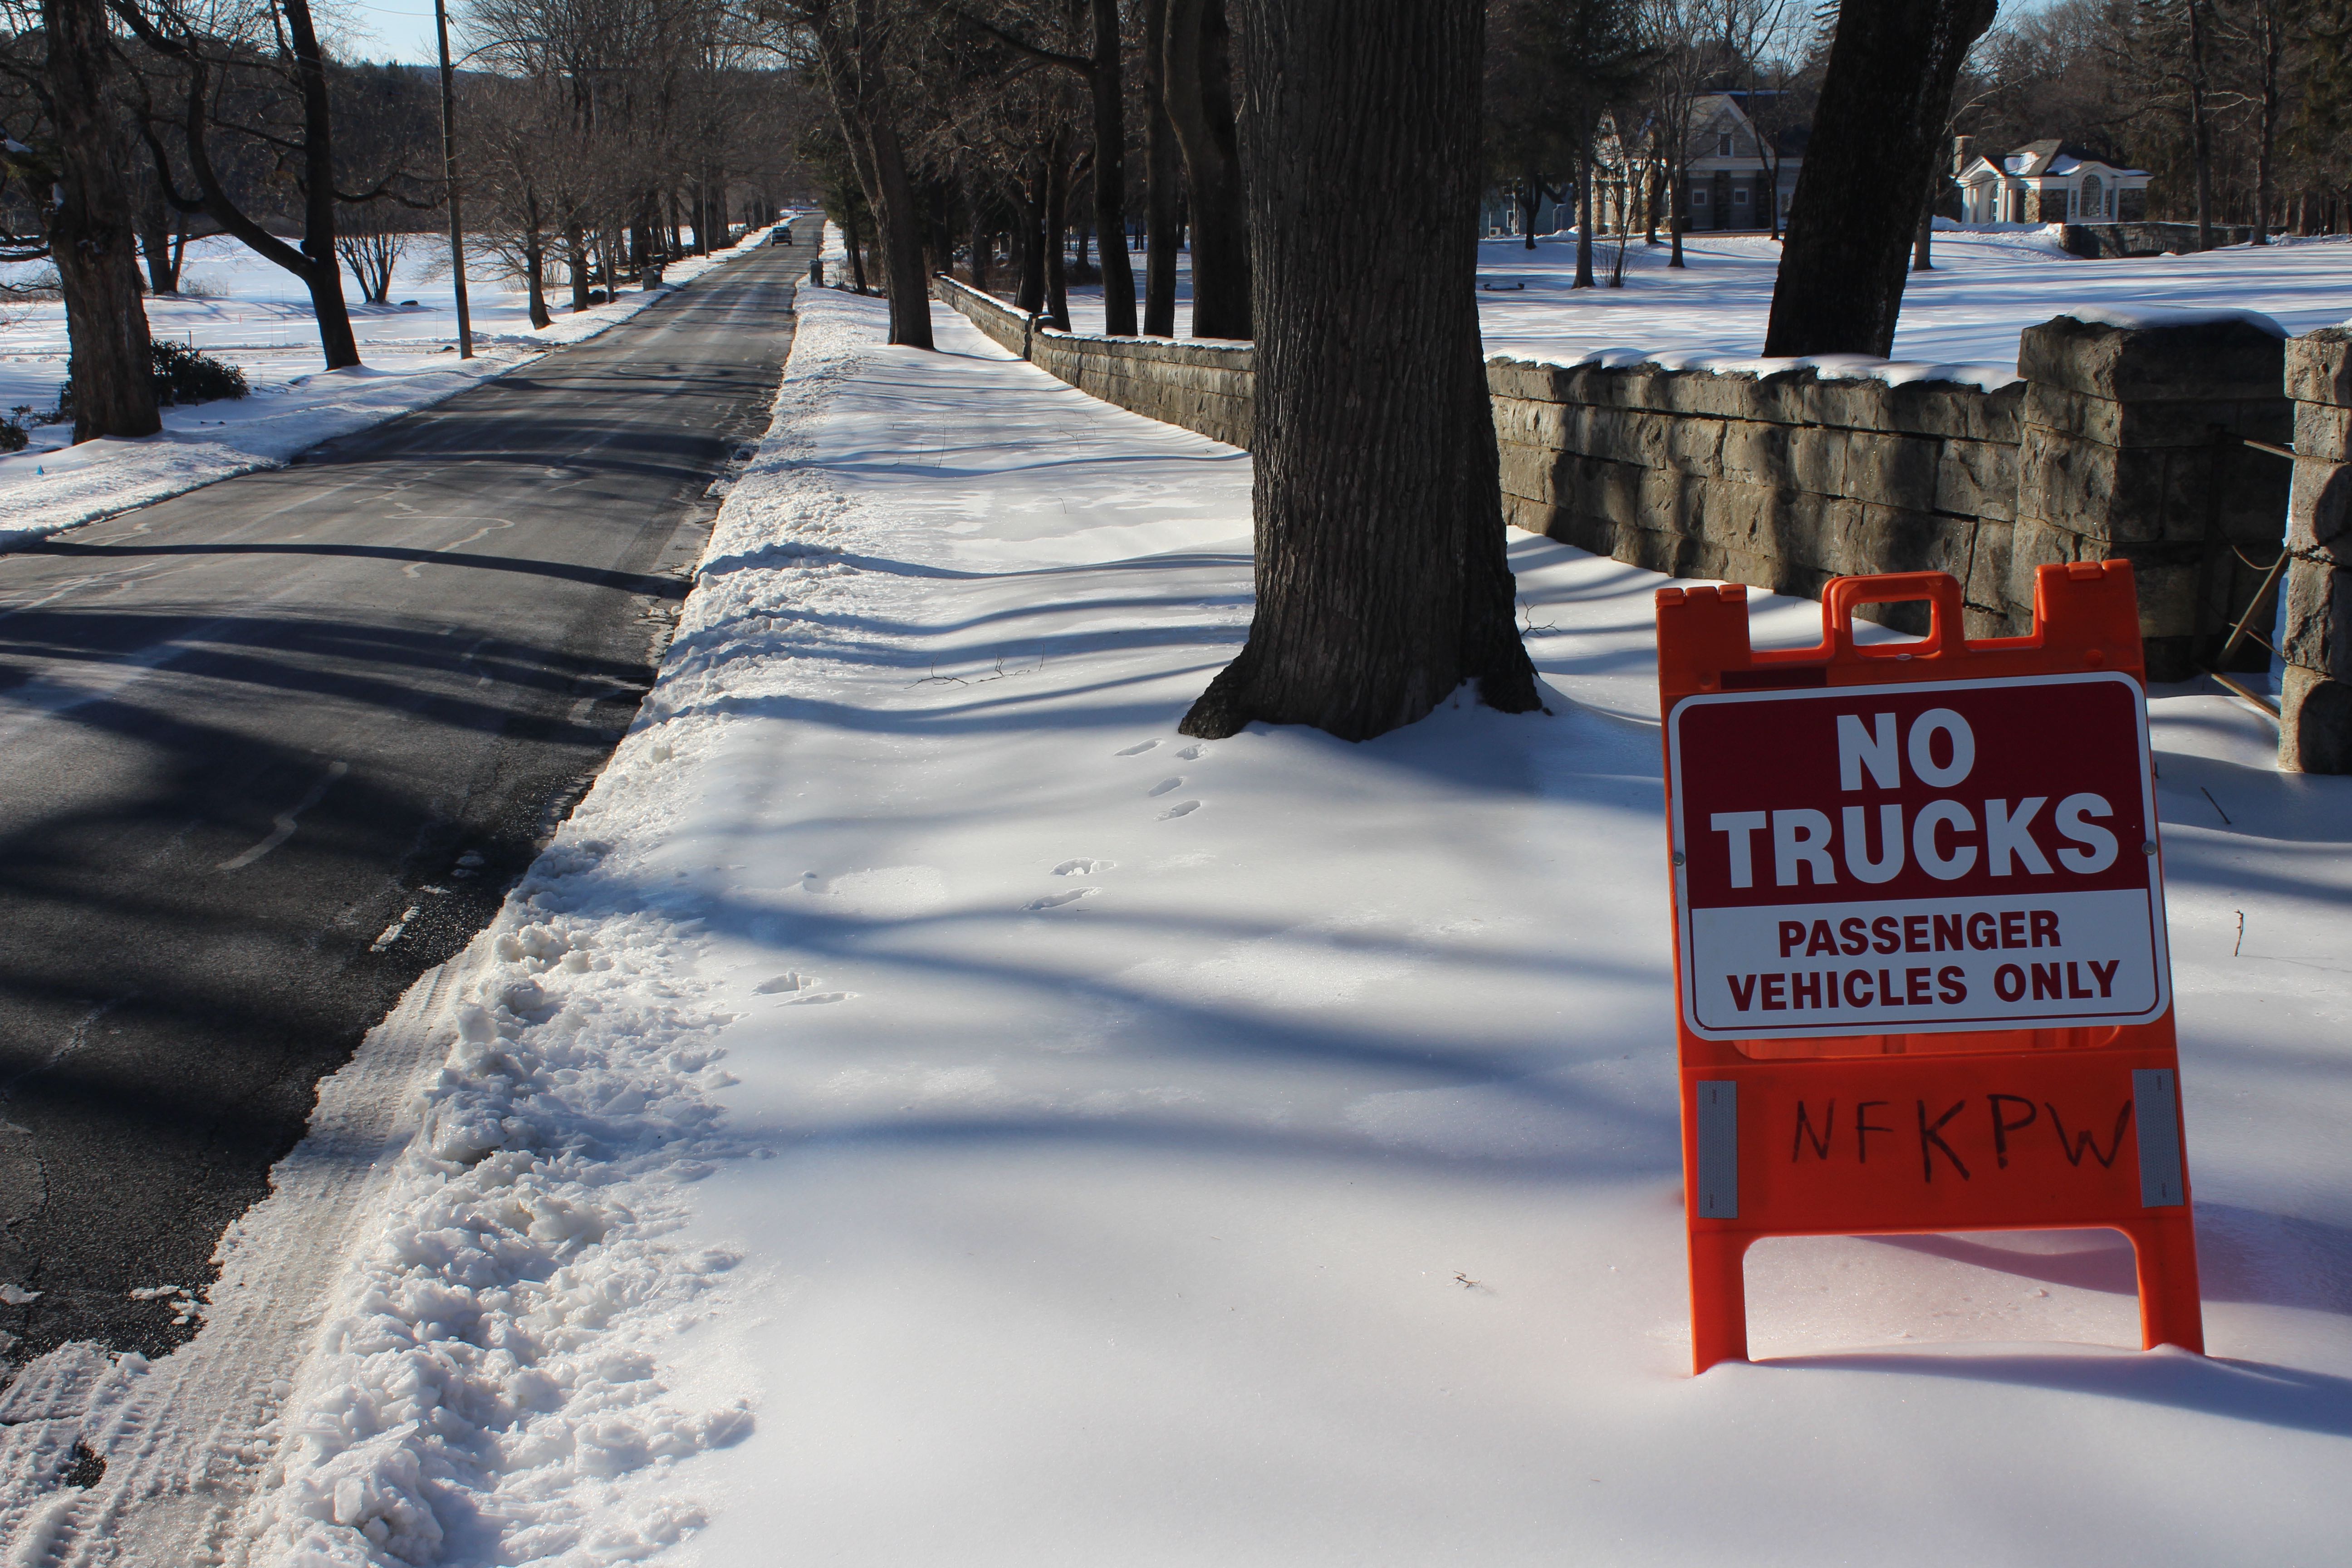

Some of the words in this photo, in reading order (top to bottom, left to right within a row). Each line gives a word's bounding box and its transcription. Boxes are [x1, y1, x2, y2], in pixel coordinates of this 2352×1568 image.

[1837, 708, 1975, 790] NO
[1711, 793, 2118, 888] TRUCKS
[1779, 911, 2061, 957] PASSENGER
[1727, 966, 1967, 1011] VEHICLES
[1994, 960, 2120, 1002] ONLY
[1793, 1094, 2132, 1185] NFKPW
